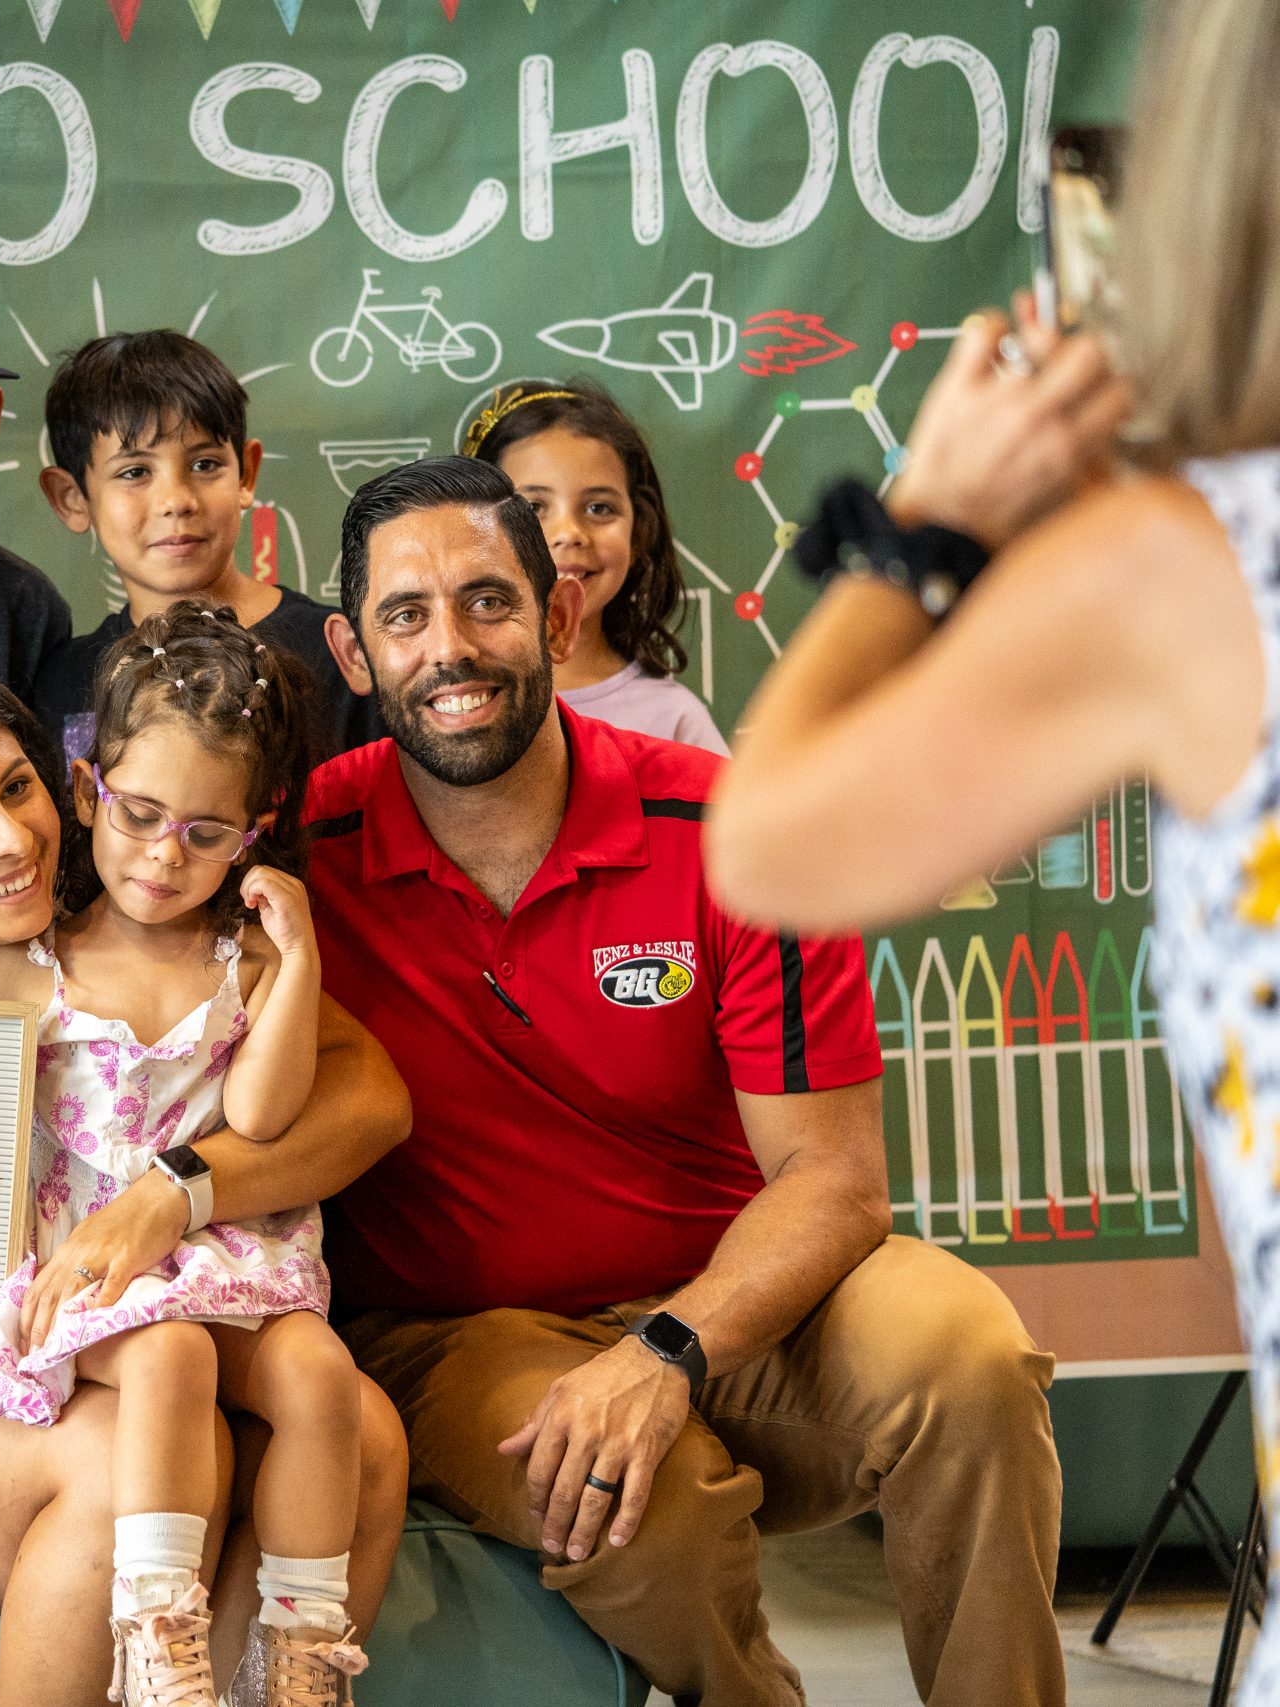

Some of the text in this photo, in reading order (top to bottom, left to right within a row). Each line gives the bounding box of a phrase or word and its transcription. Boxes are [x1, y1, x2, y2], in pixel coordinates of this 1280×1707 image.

[593, 941, 696, 978] KENZ & LESLIE
[608, 967, 661, 1000] BG
